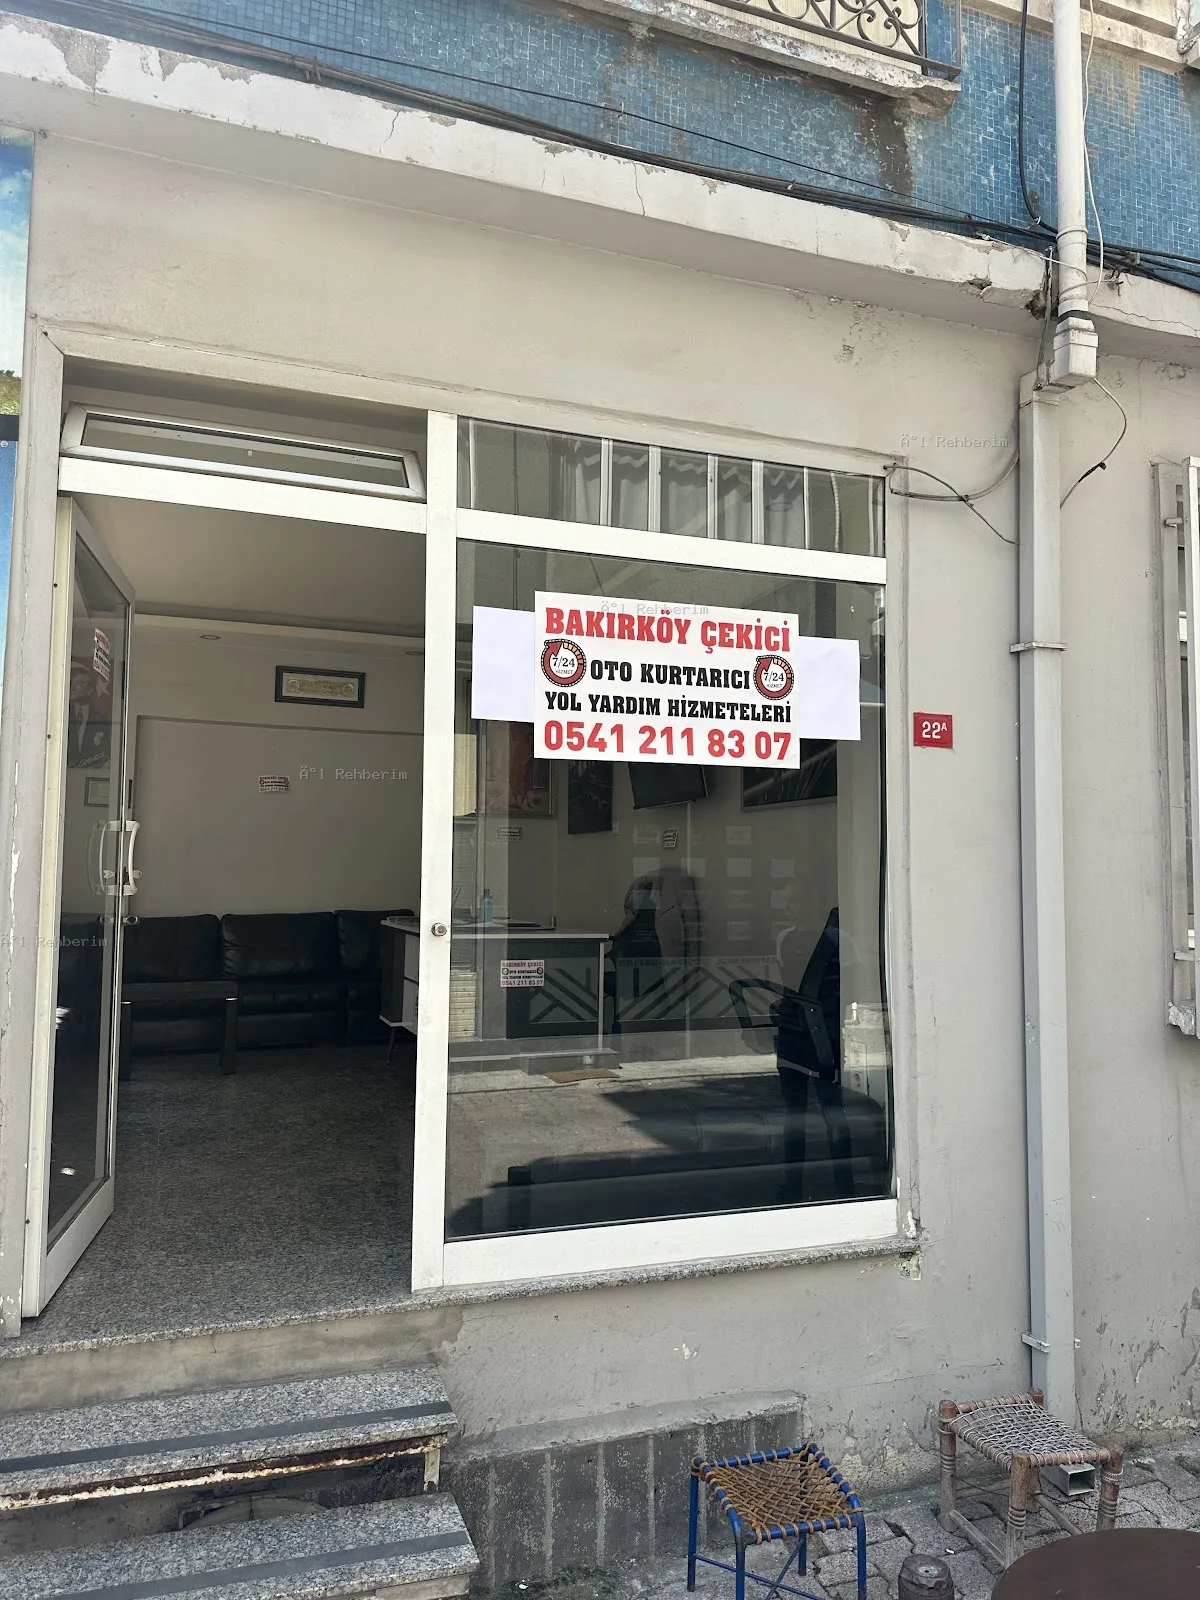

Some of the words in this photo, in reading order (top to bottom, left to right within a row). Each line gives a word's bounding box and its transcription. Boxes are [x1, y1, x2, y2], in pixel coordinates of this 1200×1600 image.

[545, 607, 691, 645] BAKIRKÖY
[701, 618, 790, 654] ÇEKİCİ
[552, 656, 575, 668] 7/24
[590, 660, 632, 682] OTO
[640, 663, 750, 690] KURTARICI
[763, 671, 784, 682] 7/24
[545, 691, 581, 711] YOL
[588, 694, 660, 715] YARDIM
[668, 695, 791, 723] HİZMETELERİ
[545, 720, 624, 753] 0541
[639, 725, 694, 756] 211
[708, 729, 745, 758] 83
[755, 731, 791, 760] 07
